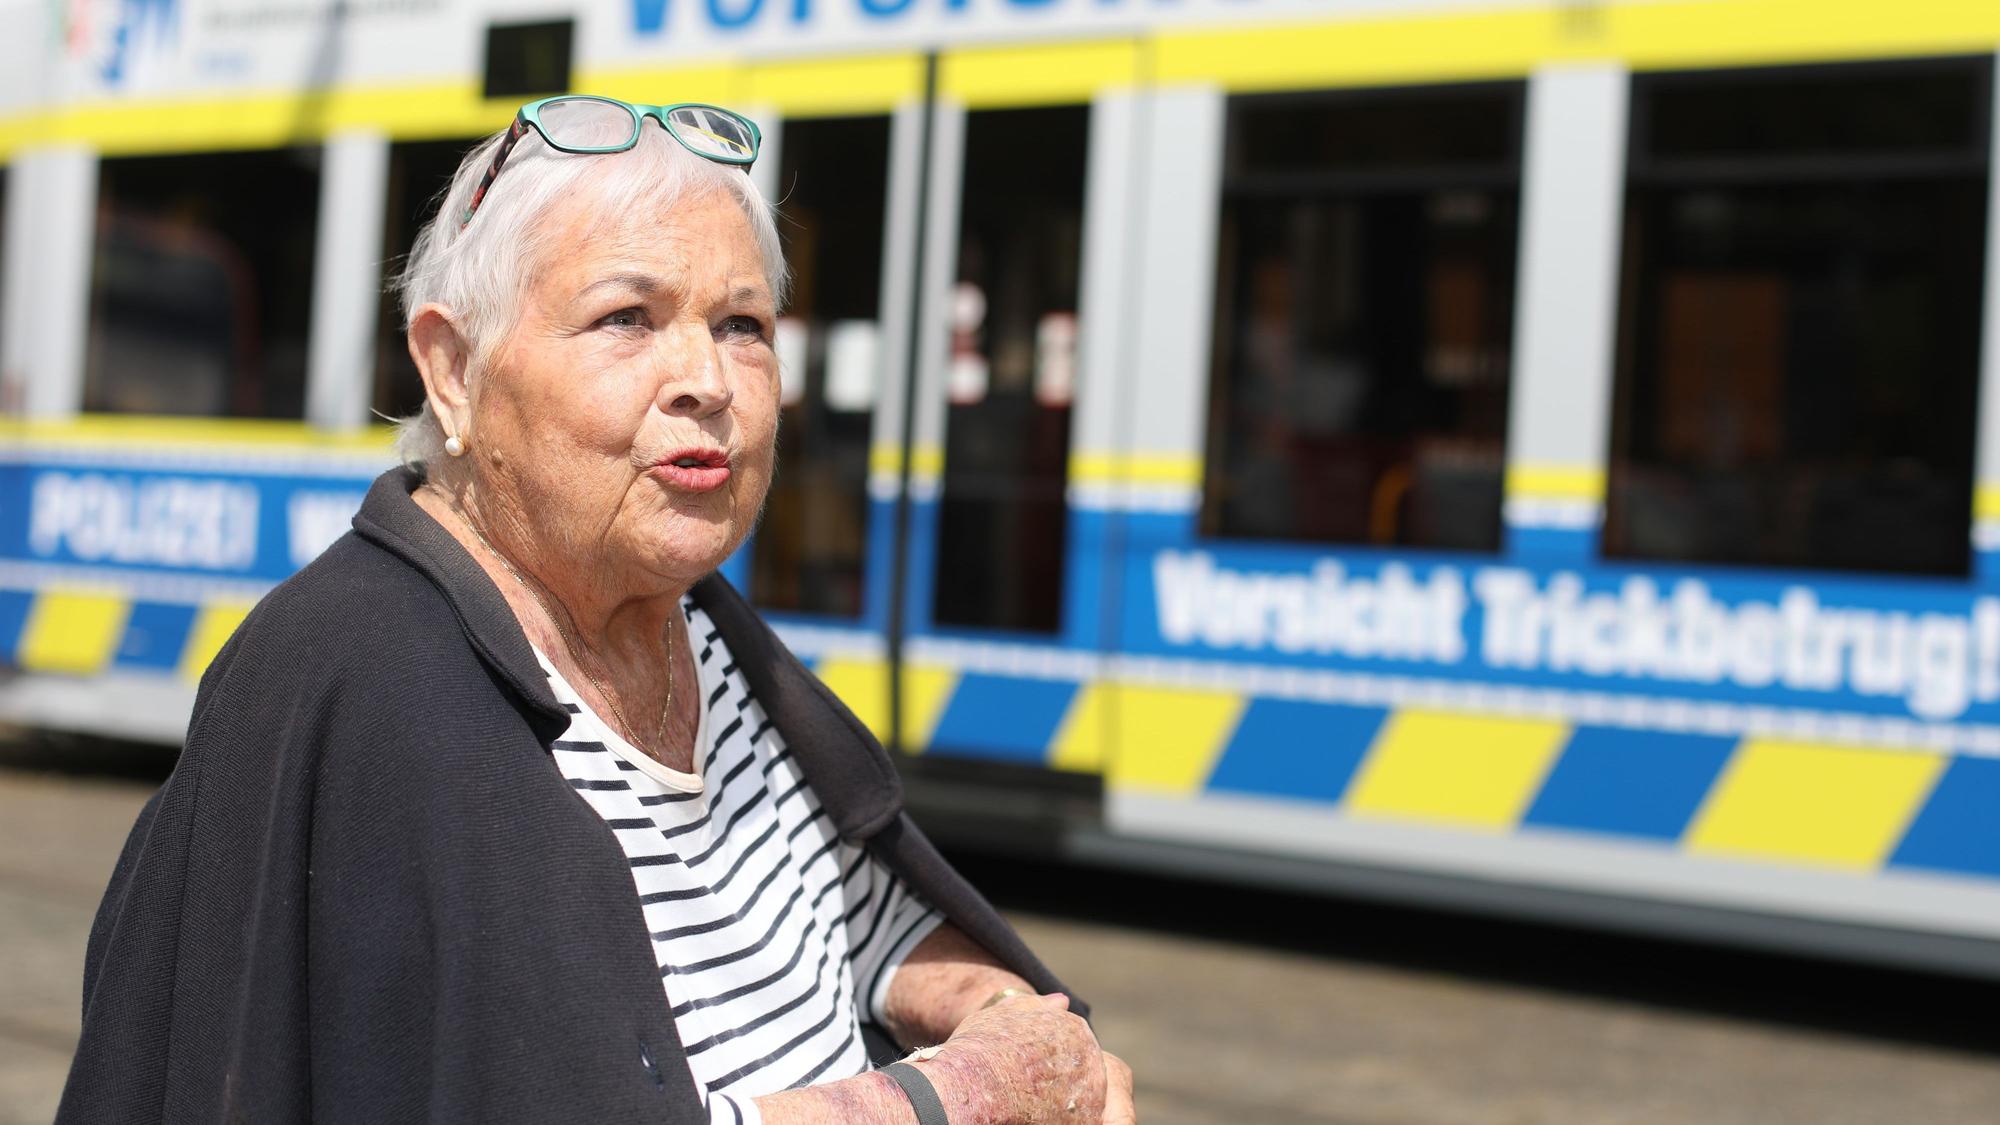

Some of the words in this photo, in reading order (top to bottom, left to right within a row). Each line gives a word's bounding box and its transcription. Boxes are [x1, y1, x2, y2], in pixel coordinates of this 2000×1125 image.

[29, 472, 260, 570] POLIZEI
[1154, 549, 1466, 664] Vorsicht
[1475, 566, 2000, 719] Trickbetrug!
